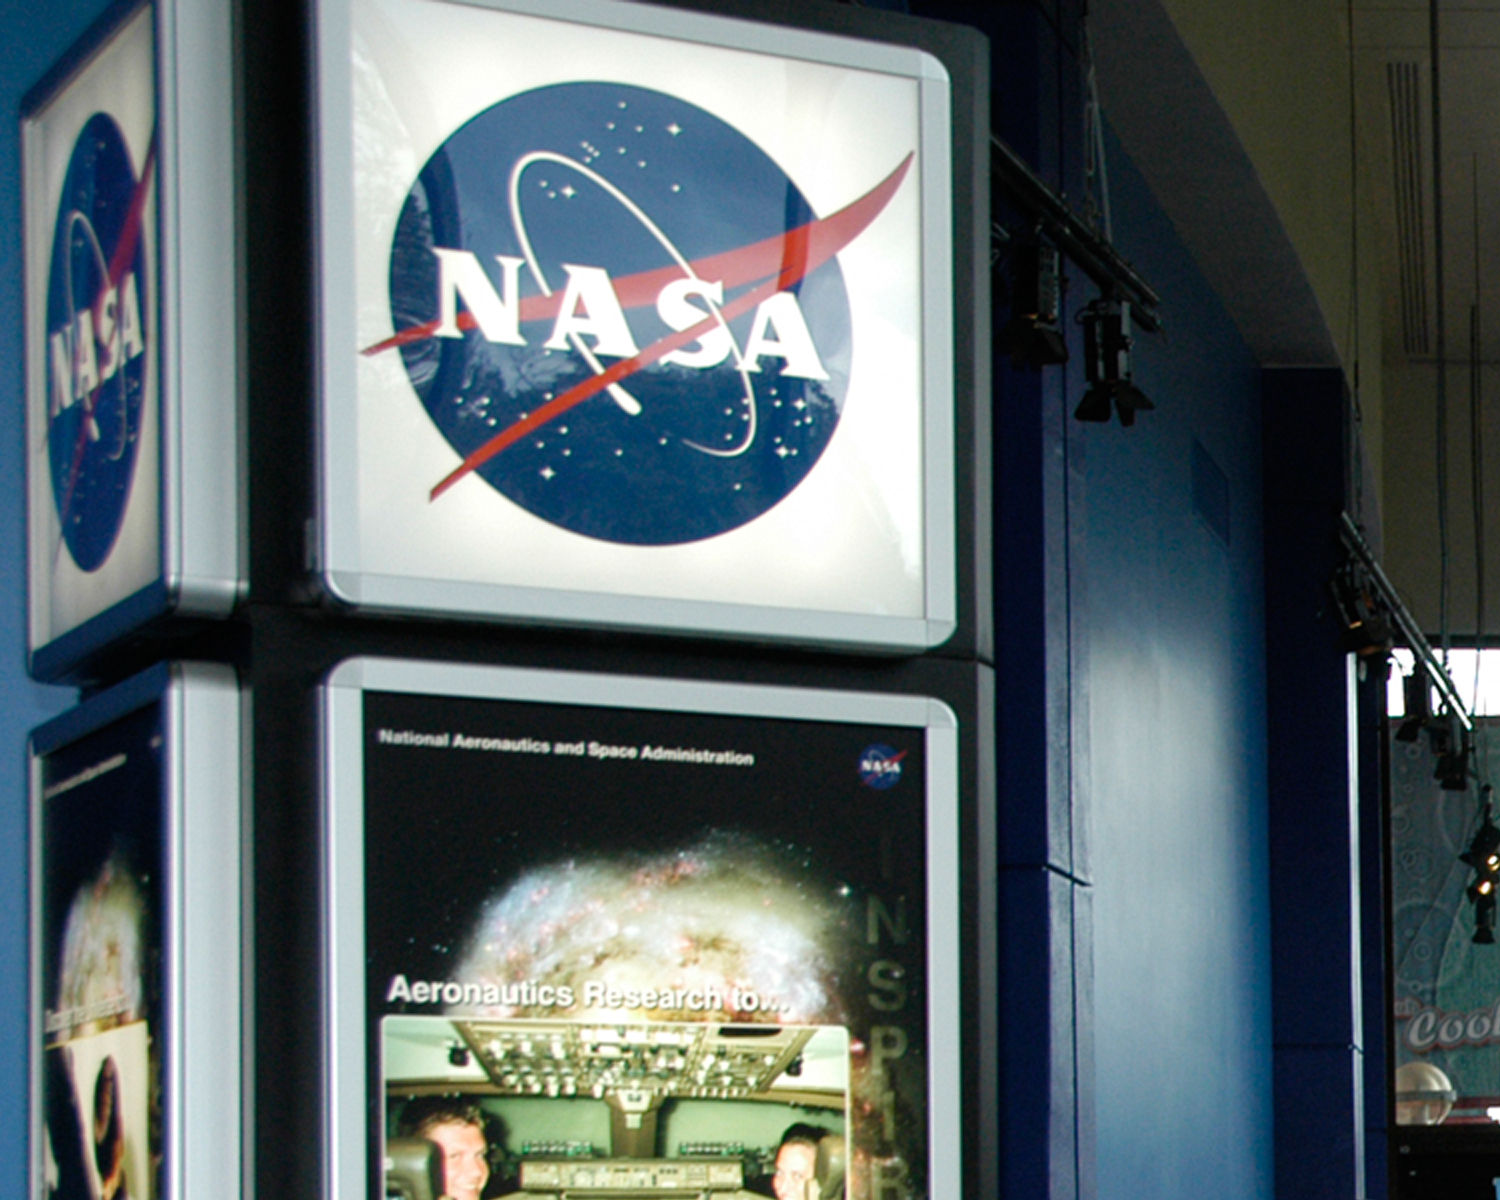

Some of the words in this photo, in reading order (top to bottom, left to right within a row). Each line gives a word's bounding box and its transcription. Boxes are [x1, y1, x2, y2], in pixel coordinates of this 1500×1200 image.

[432, 247, 830, 381] NASA
[50, 272, 144, 418] NASA
[378, 728, 450, 748] National
[453, 734, 551, 754] Aeronautics
[553, 741, 585, 756] and
[587, 742, 638, 762] Space
[641, 746, 754, 766] Administration
[861, 759, 901, 774] NASA
[387, 974, 574, 1007] Aeronautics
[583, 981, 723, 1010] Research
[732, 985, 791, 1013] to...
